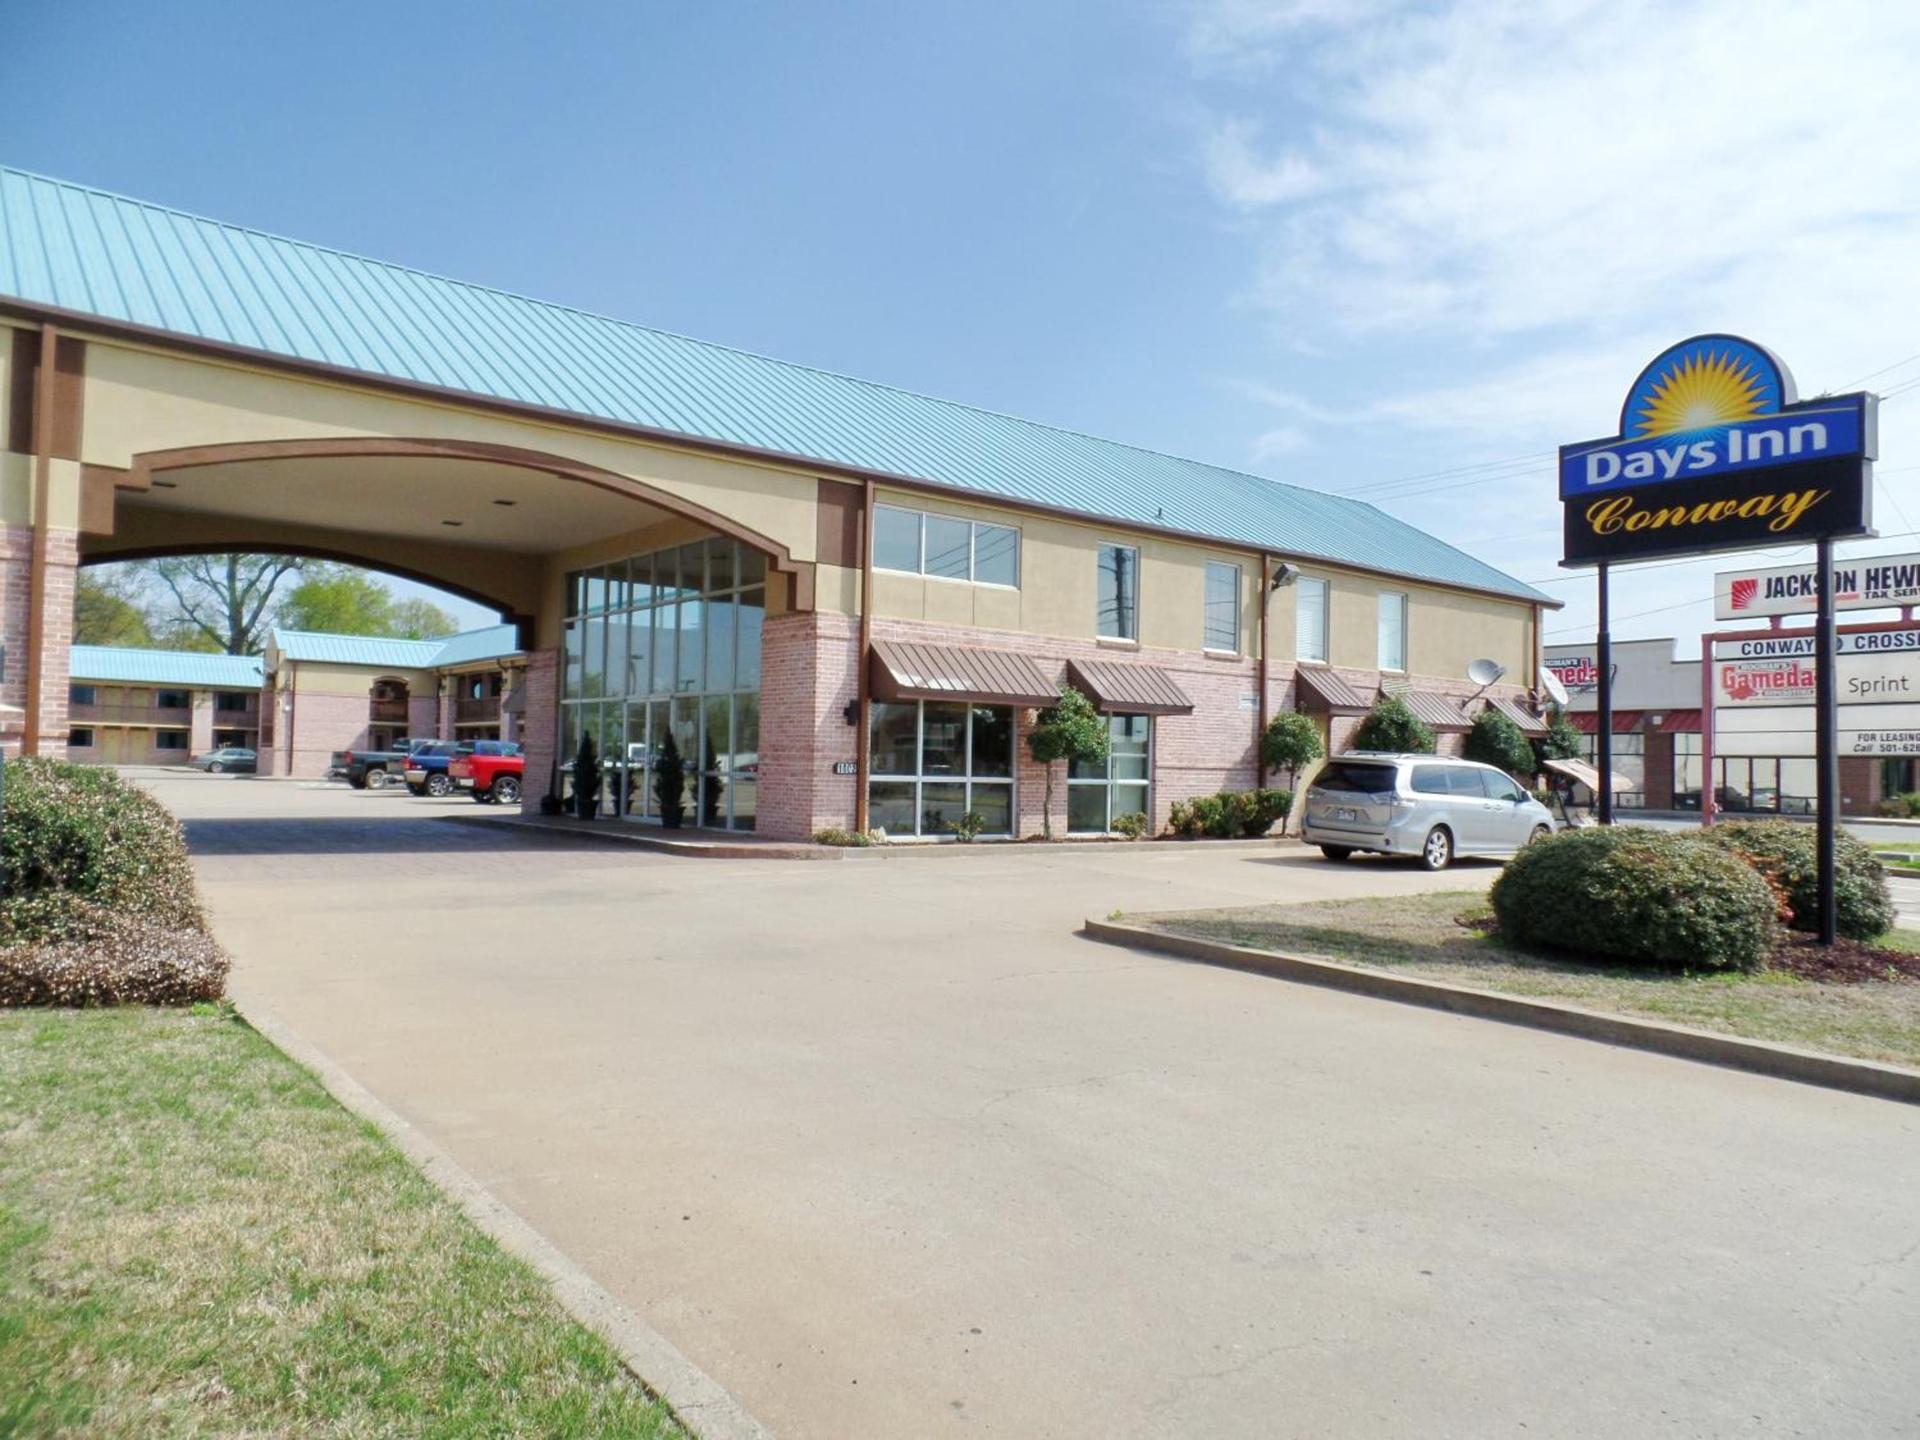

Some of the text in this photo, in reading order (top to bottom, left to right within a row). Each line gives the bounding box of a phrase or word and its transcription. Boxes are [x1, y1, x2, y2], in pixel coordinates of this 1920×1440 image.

[1586, 422, 1828, 485] Days Inn
[1586, 489, 1832, 535] Conway
[1864, 590, 1888, 600] TAX
[1741, 638, 1814, 656] CONWAY
[1722, 662, 1818, 689] Gameda
[1848, 675, 1910, 697] Sprint
[1857, 733, 1877, 742] FOR
[1853, 743, 1873, 753] Call
